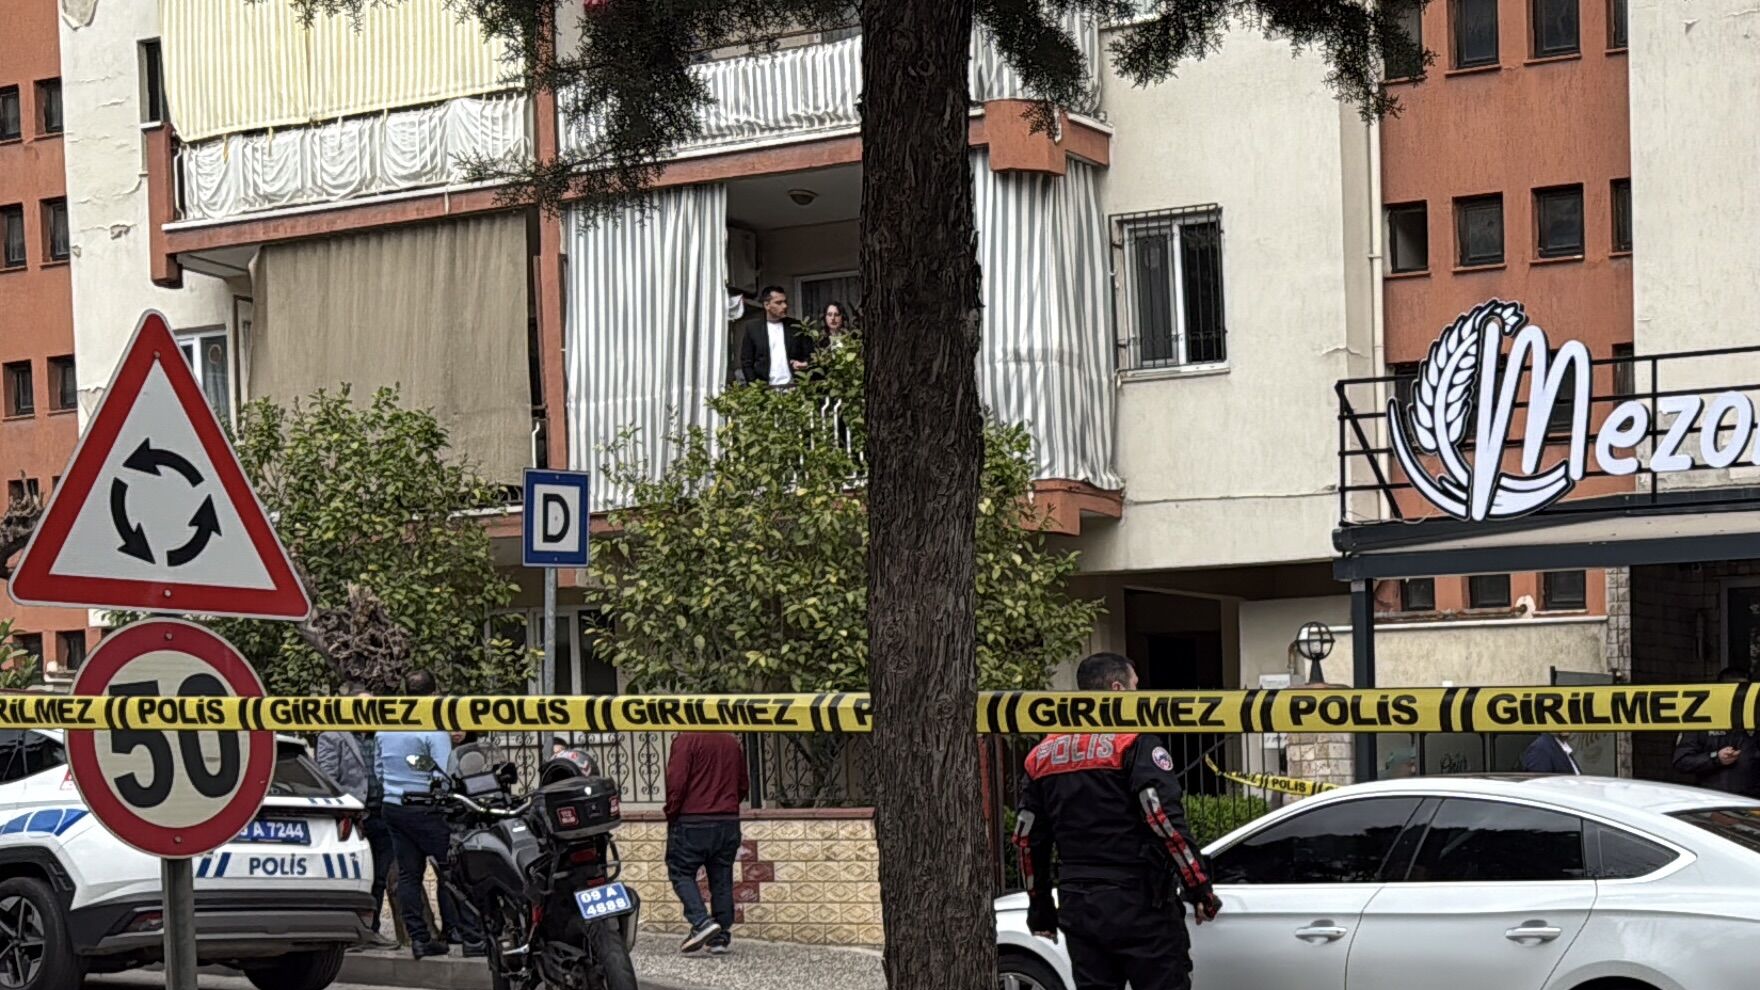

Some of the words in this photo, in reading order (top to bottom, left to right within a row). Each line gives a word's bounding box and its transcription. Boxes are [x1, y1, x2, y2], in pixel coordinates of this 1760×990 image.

[542, 493, 570, 543] D
[137, 698, 225, 724] POLİS
[270, 698, 422, 725] GİRİLMEZ
[470, 698, 570, 725] POLİS
[622, 698, 798, 726] GİRİLMEZ
[1028, 696, 1225, 727] GİRİLMEZ
[1290, 694, 1419, 726] POLİS
[1487, 690, 1712, 726] GİRİLMEZ
[108, 673, 241, 808] 50
[249, 854, 307, 875] POLİS
